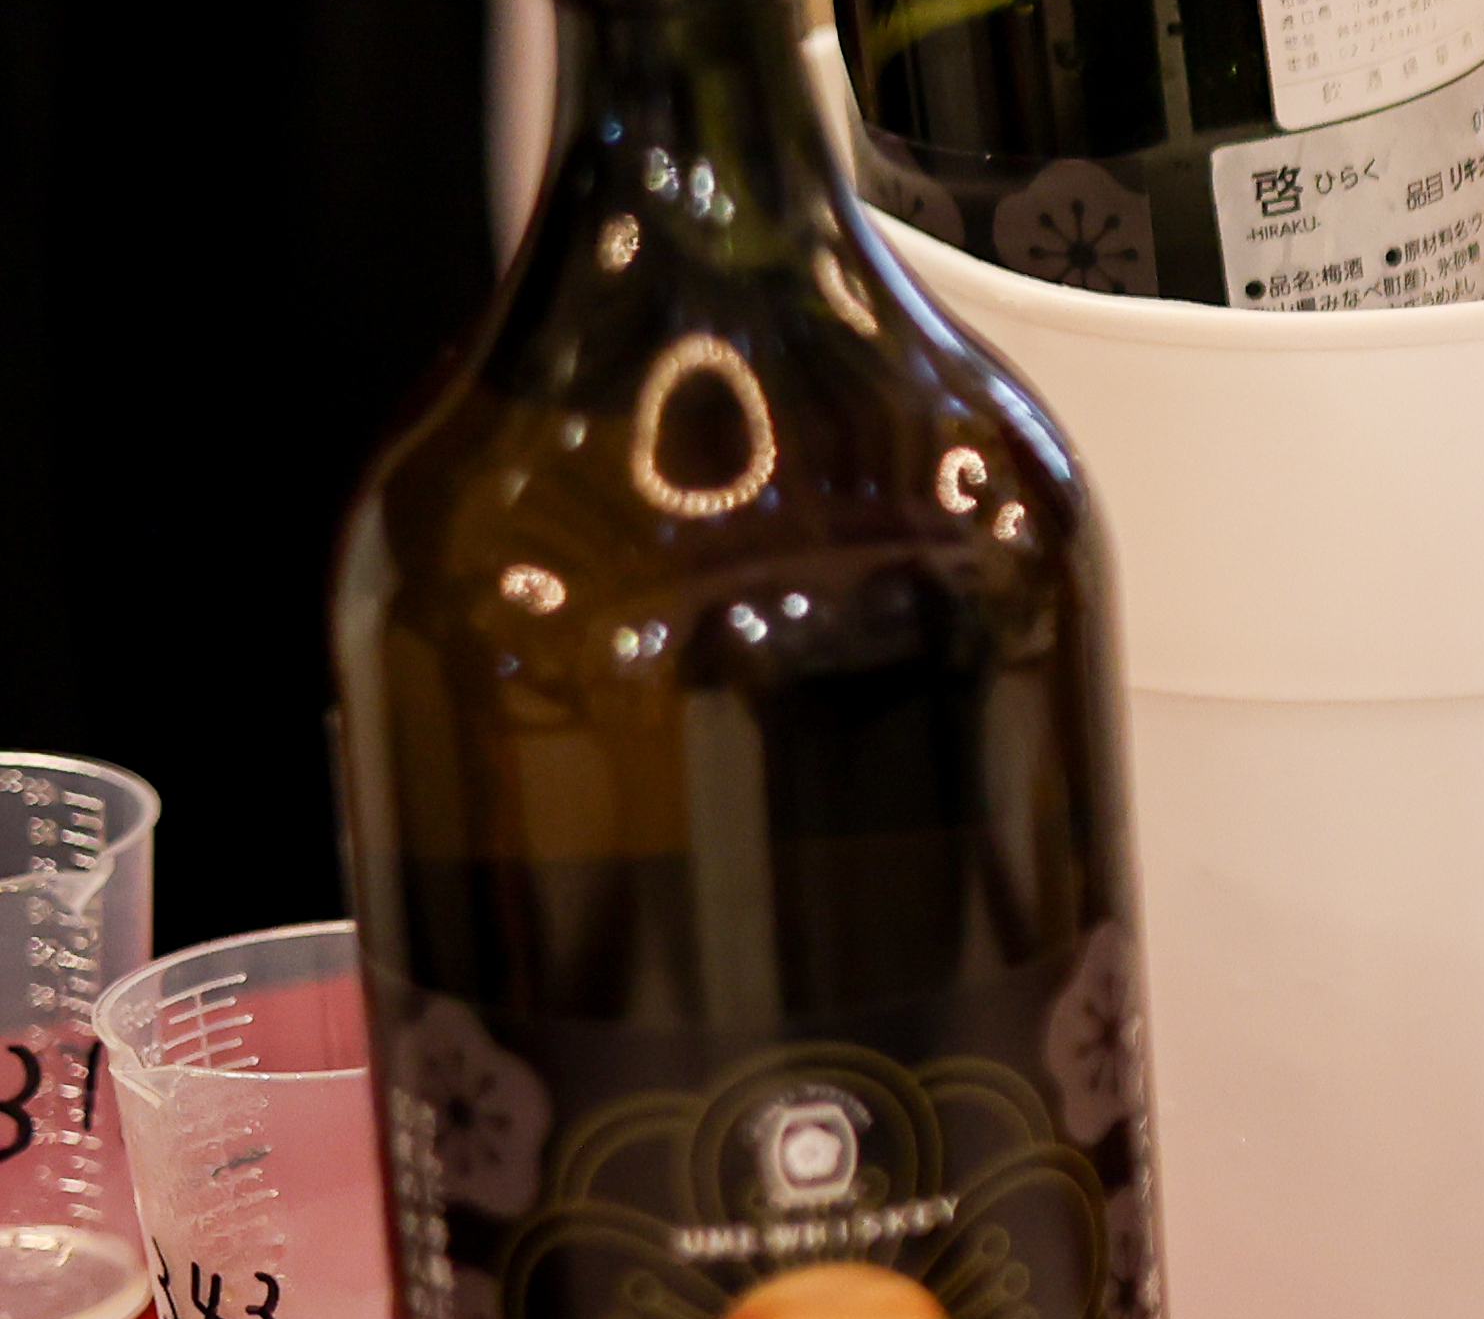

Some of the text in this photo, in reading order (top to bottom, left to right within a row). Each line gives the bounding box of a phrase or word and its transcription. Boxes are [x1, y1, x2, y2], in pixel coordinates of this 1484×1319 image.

[1250, 164, 1304, 218] 啓
[1314, 157, 1380, 196] ひらく
